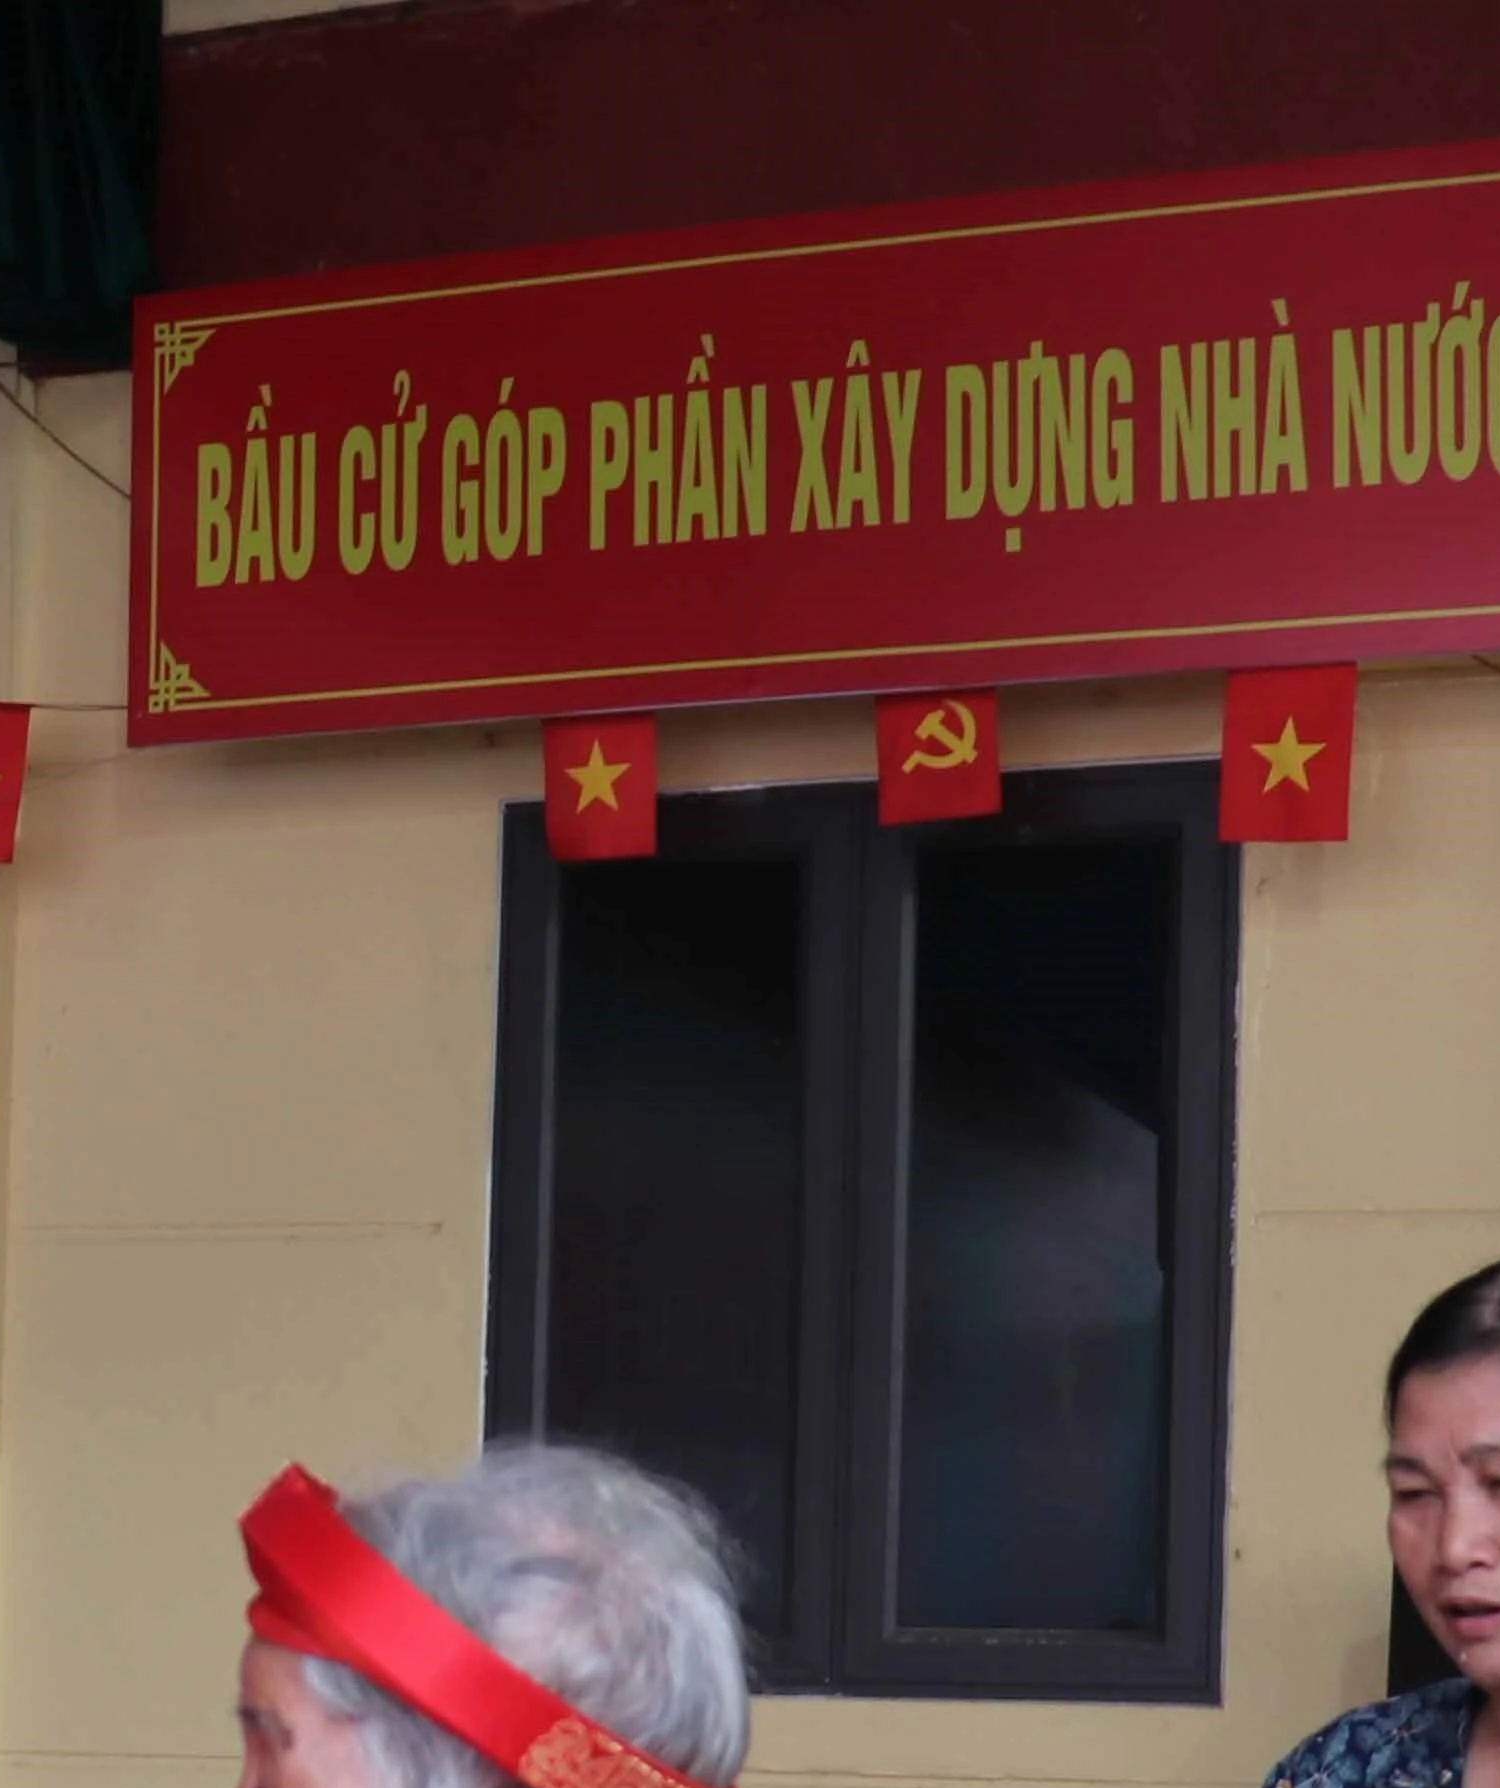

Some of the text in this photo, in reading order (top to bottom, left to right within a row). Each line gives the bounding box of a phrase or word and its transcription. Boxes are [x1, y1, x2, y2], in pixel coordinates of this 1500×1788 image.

[196, 384, 317, 587] BẦU
[338, 371, 428, 574] CỬ
[442, 377, 566, 565] GÓP
[590, 335, 767, 550] PHẦN
[791, 340, 921, 532] XÂY
[946, 341, 1134, 552] DỰNG
[1160, 298, 1309, 503] NHÀ
